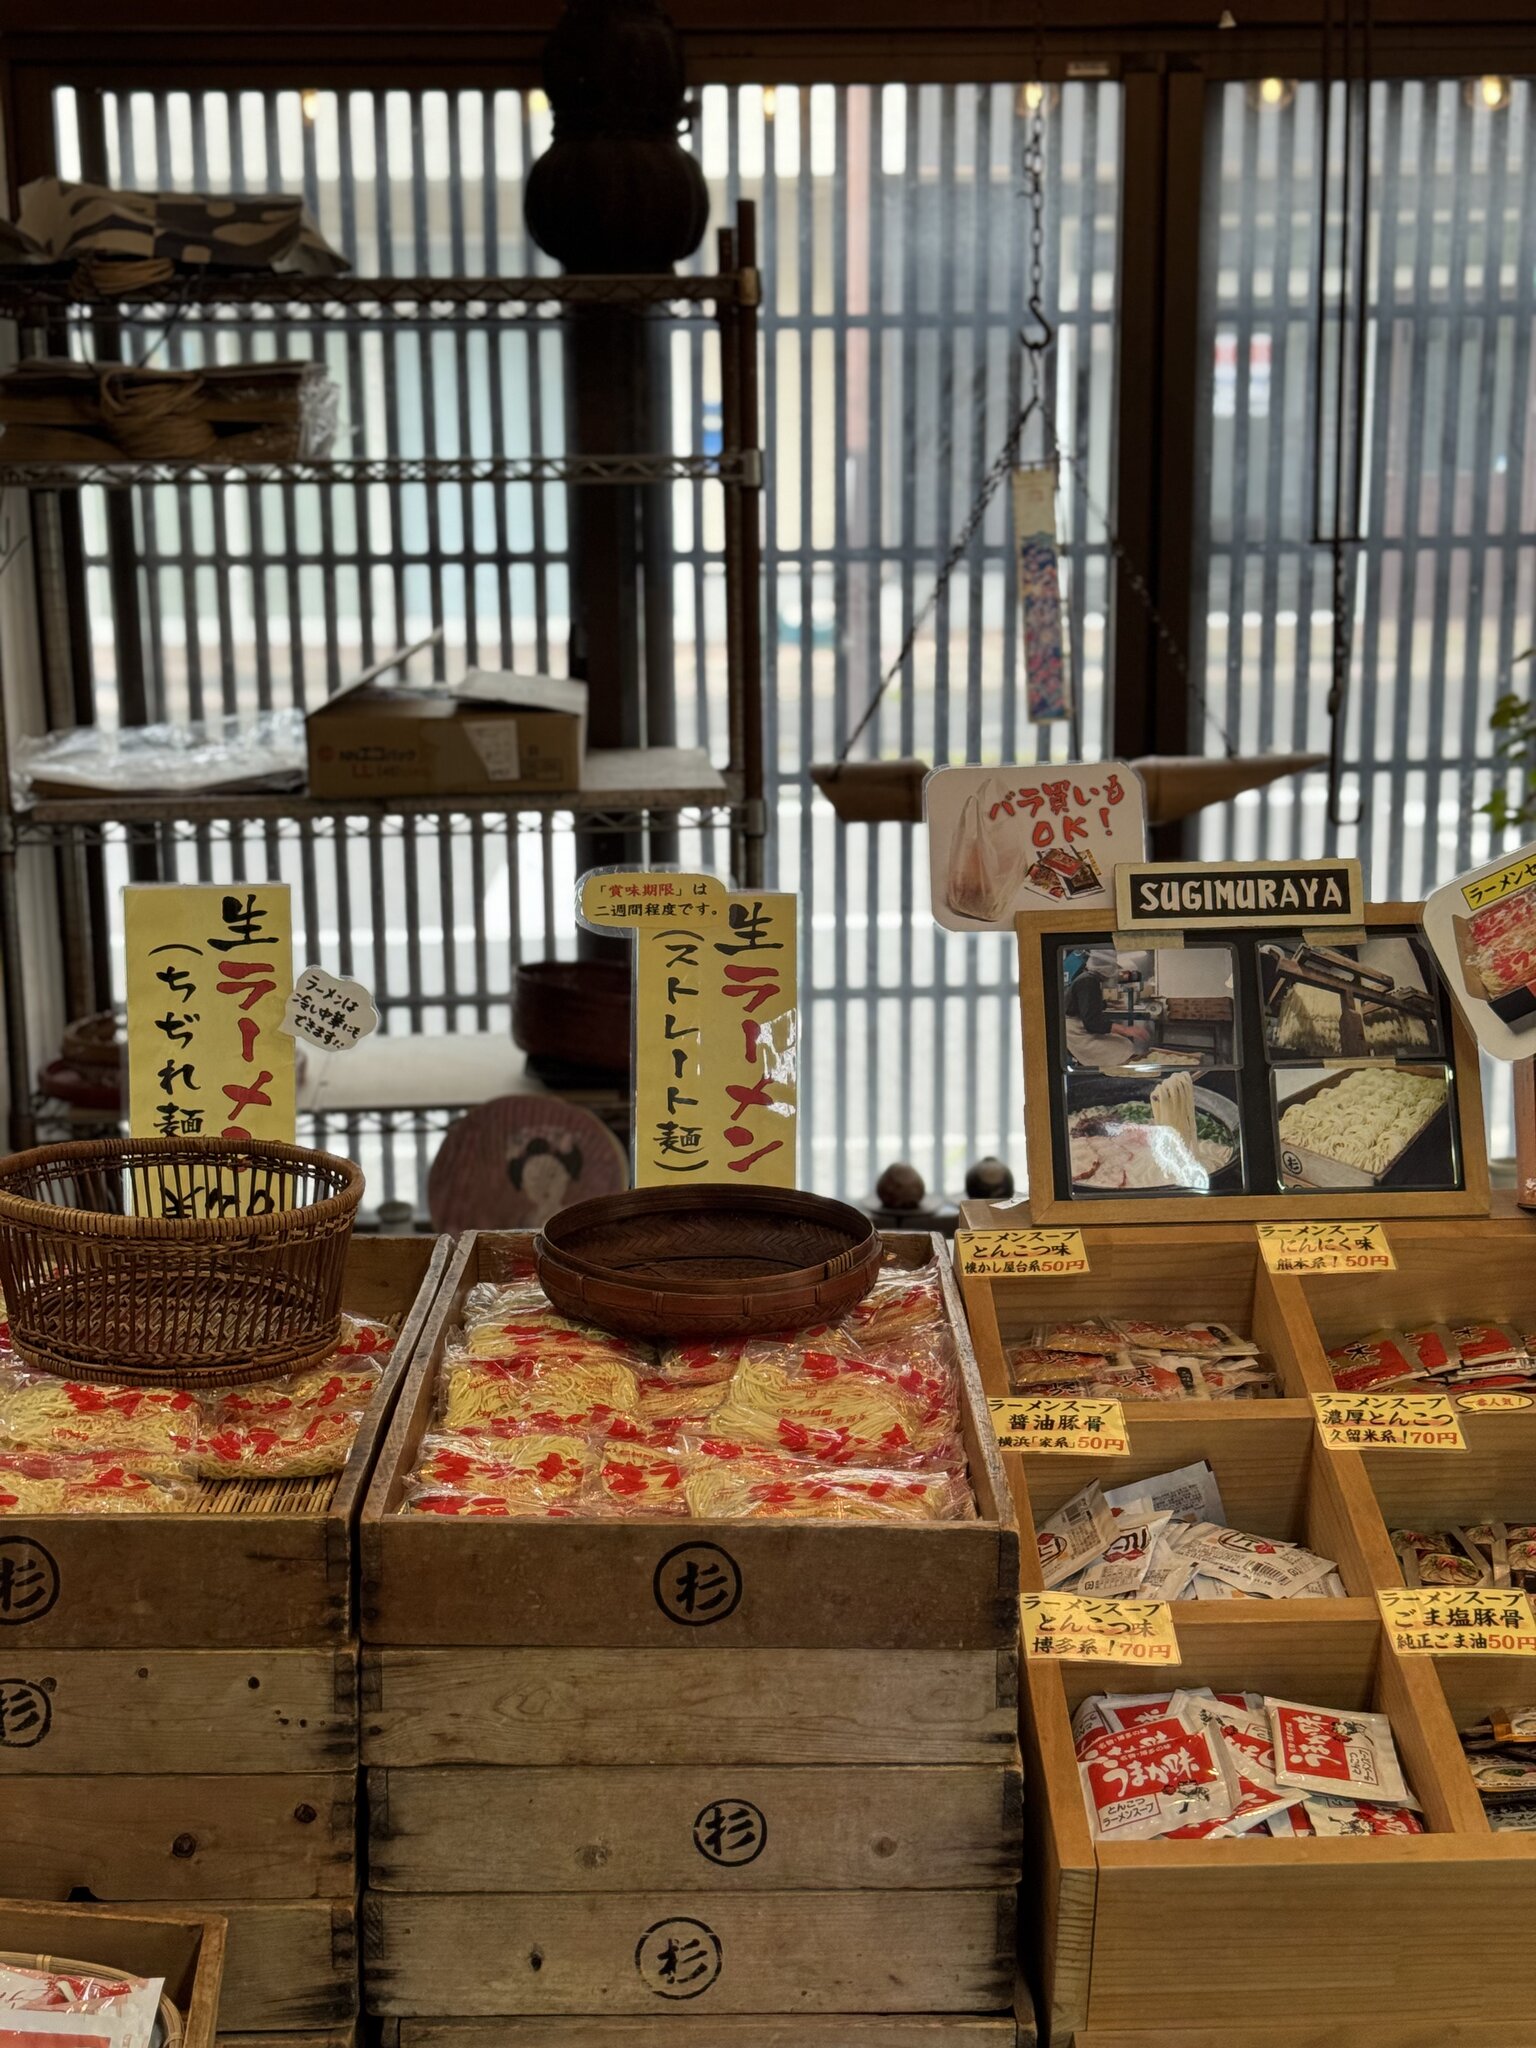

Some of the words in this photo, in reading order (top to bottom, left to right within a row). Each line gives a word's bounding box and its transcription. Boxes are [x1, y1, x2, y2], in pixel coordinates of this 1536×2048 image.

[990, 774, 1126, 820] バラ買いも
[1031, 808, 1113, 847] OK!
[1139, 877, 1343, 912] SUGIMURAYA
[594, 902, 718, 917] 二週間程度です。
[305, 974, 359, 1013] ラーメンは
[292, 992, 361, 1039] 冷し中華にも
[713, 901, 784, 1173] 生ラーメン
[651, 929, 709, 1172] (ストレート麺)
[960, 1230, 1079, 1243] ラーメンスープ
[1259, 1223, 1379, 1237] ラーメンスープ
[973, 1243, 1071, 1258] とんこつ味
[1280, 1236, 1374, 1253] にんにく味
[988, 1399, 1118, 1414] ラーメンスープ
[1316, 1395, 1447, 1409] ラーメンスープ
[1008, 1413, 1106, 1432] 醤油豚骨
[1322, 1409, 1454, 1426] 濃厚とんこつ
[1023, 1595, 1165, 1616] ラーメンスープ
[1381, 1591, 1524, 1607] ラーメンスープ
[1038, 1613, 1157, 1638] とんこつ味
[1394, 1607, 1525, 1630] ごま塩豚骨
[1102, 1803, 1155, 1827] ラーメンスープ
[1107, 1798, 1147, 1815] とんこつ
